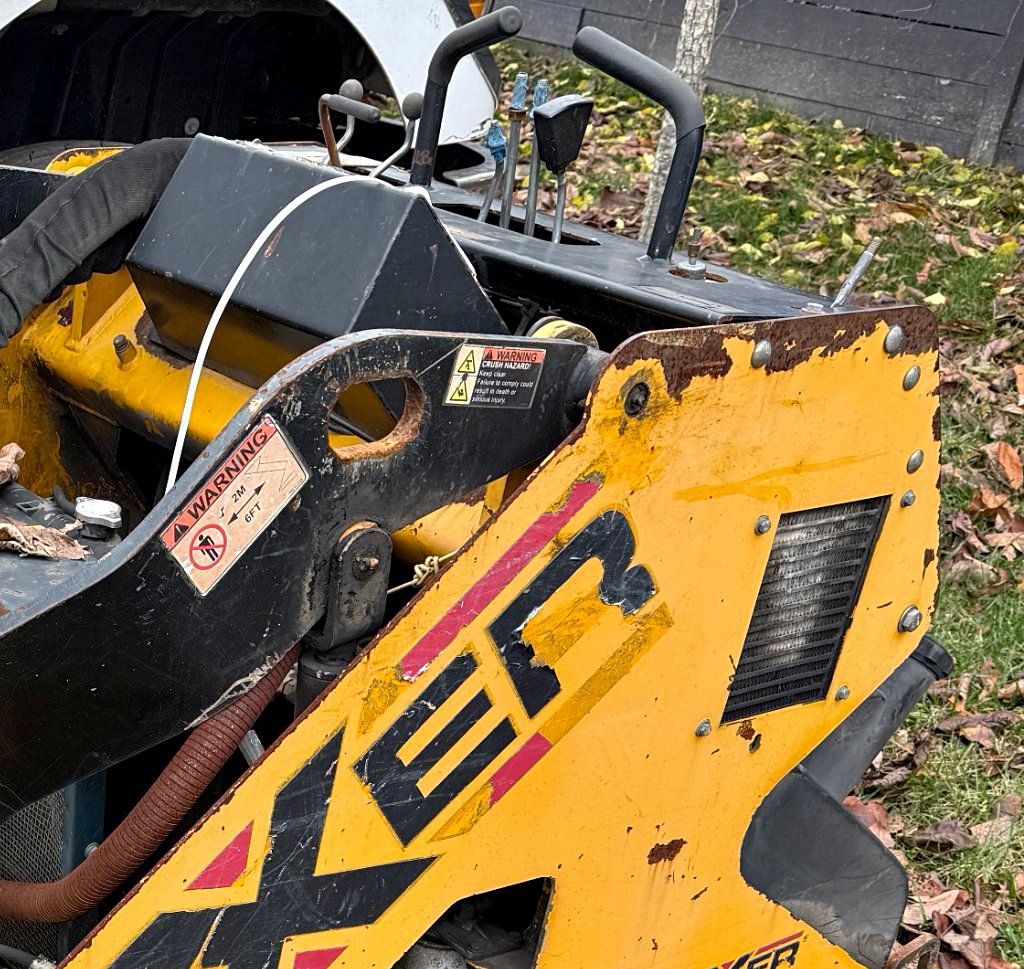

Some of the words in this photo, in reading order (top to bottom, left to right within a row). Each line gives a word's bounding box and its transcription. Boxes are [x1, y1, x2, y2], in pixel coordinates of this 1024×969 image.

[496, 350, 538, 362] WARNING
[481, 360, 503, 368] CRUSH
[504, 362, 531, 370] HAZARD!
[501, 380, 519, 388] comply
[187, 429, 268, 520] WARNING
[231, 484, 247, 503] 2M
[244, 501, 263, 523] 6FT
